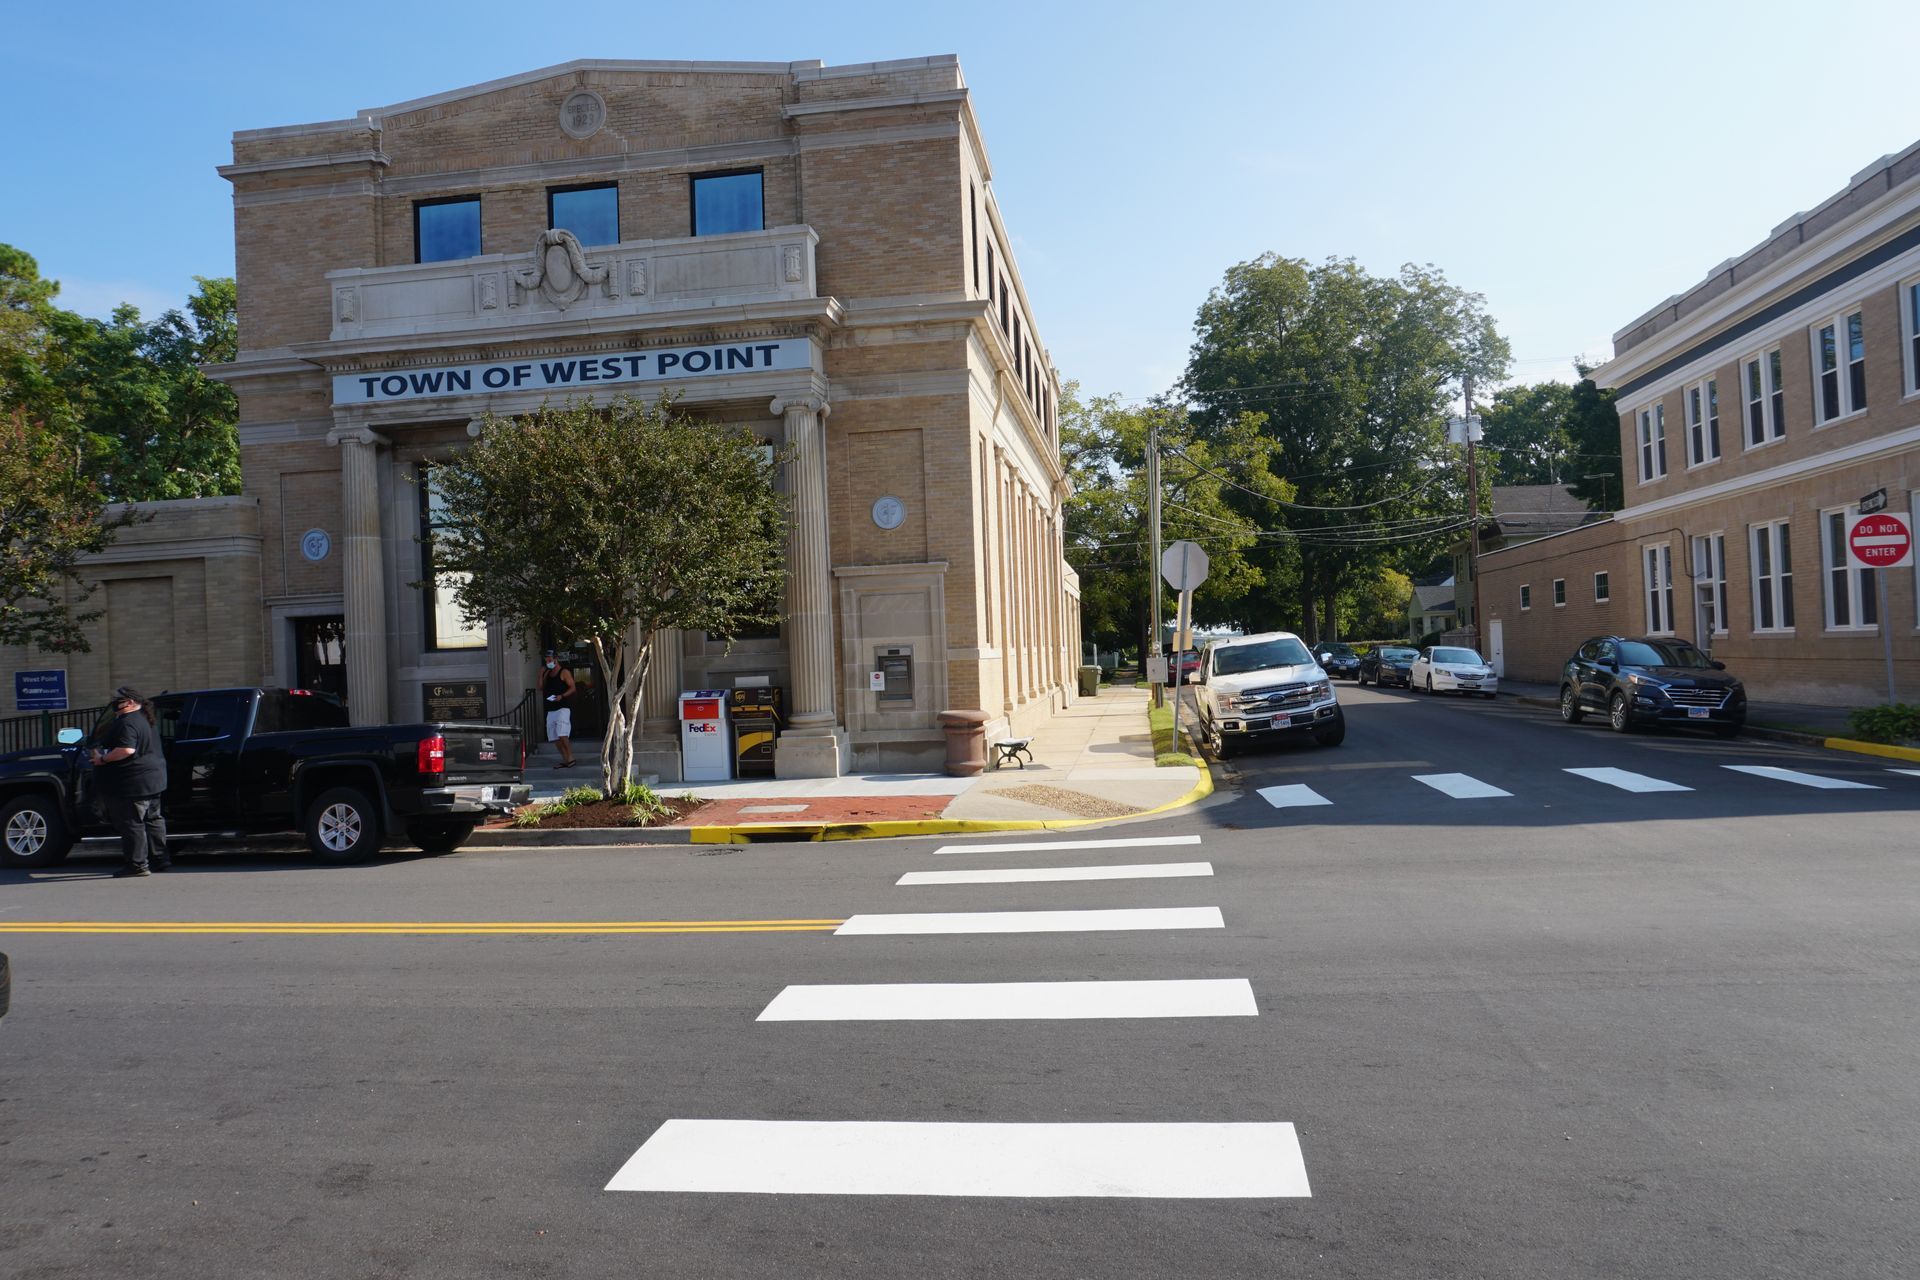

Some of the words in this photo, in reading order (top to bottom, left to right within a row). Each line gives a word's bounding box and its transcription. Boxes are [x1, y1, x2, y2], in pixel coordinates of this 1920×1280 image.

[358, 369, 472, 398] TOWN
[481, 363, 532, 389] OF
[539, 355, 648, 385] WEST
[656, 343, 780, 375] POINT
[1859, 525, 1872, 534] DO
[1879, 524, 1898, 533] NOT
[1865, 548, 1896, 557] ENTER
[689, 723, 716, 733] FedEx
